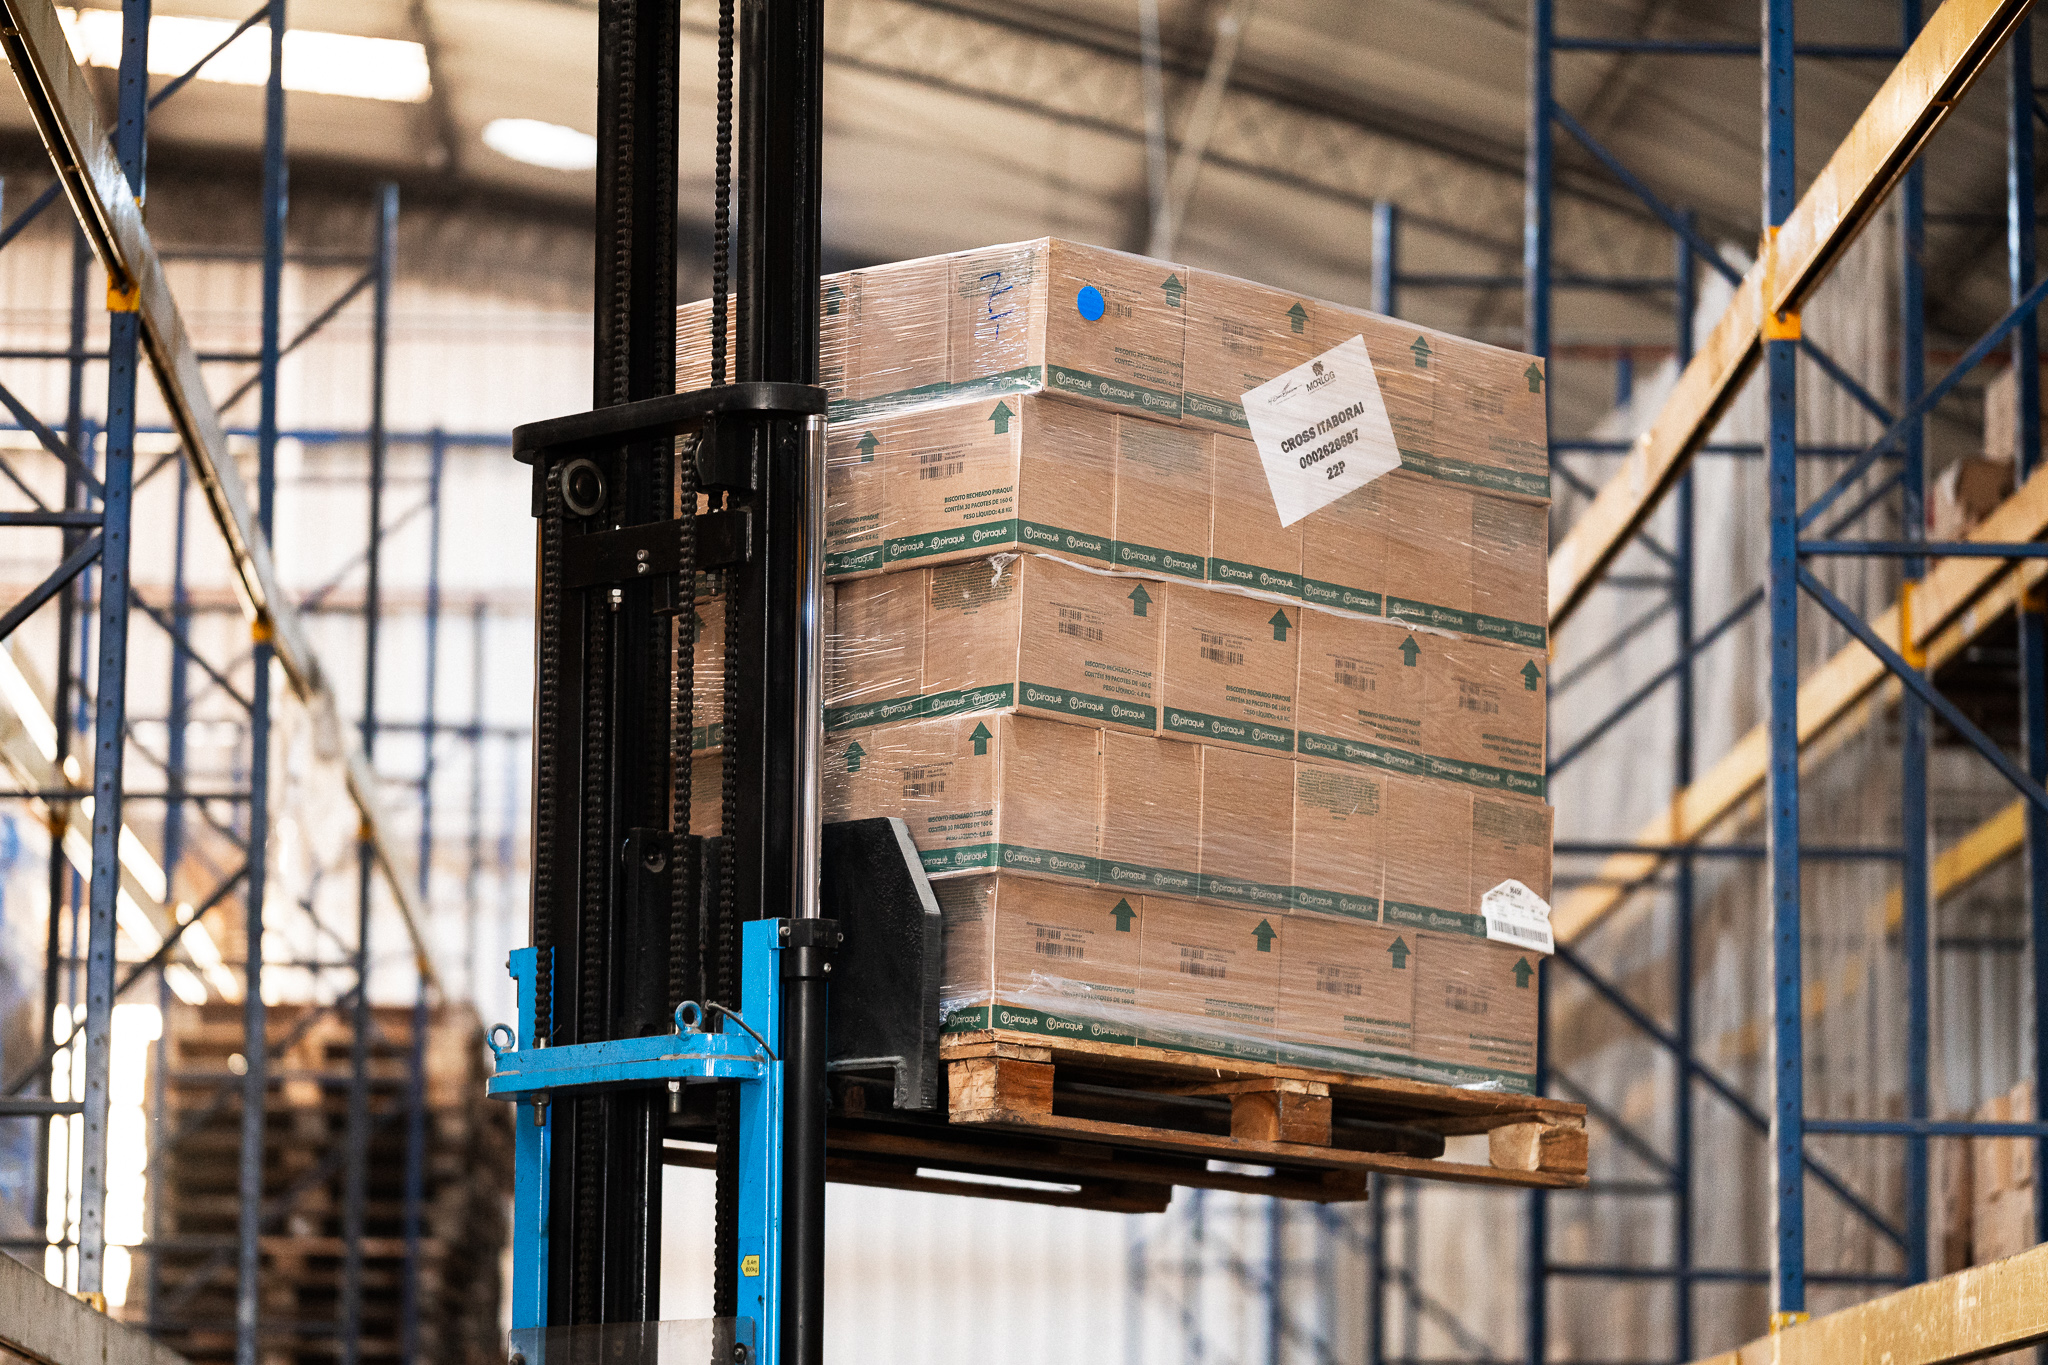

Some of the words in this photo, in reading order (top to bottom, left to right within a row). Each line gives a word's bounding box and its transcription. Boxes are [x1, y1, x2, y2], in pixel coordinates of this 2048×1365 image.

[1306, 371, 1336, 392] MORLOG
[1065, 375, 1092, 389] piraquê
[1109, 386, 1135, 400] piraquê
[1152, 396, 1177, 410] piraquê
[1280, 426, 1316, 454] CROSS
[1317, 402, 1365, 436] ITABORAI
[1326, 460, 1346, 480] 22P
[945, 494, 965, 503] BISCOITO
[966, 490, 991, 499] RECHEADO
[992, 486, 1013, 495] PIRAQUÊ
[945, 505, 964, 513] CONTÉM
[971, 500, 991, 508] PACOTES
[976, 510, 997, 518] LÍQUIDO:
[900, 541, 924, 554] piraquê
[940, 534, 965, 548] piraquê
[981, 527, 1008, 540] piraquê
[1033, 529, 1059, 543] piraquê
[1076, 539, 1101, 551] piraquê
[1131, 551, 1156, 563] piraquê
[1172, 559, 1198, 571] piraquê
[1229, 568, 1253, 580] piraquê
[1269, 575, 1293, 588] piraquê
[1312, 586, 1337, 600] piraquê
[1351, 594, 1375, 606] piraquê
[889, 703, 913, 715] piraquê
[940, 696, 965, 709] piraquê
[981, 690, 1006, 704] piraquê
[1036, 692, 1062, 704] piraquê
[1078, 700, 1104, 712] piraquê
[1120, 707, 1145, 720] piraquê
[1179, 717, 1204, 728] piraquê
[1220, 724, 1245, 736] piraquê
[1261, 732, 1285, 743] piraquê
[1314, 740, 1338, 752] piraquê
[1392, 755, 1415, 767] piraquê
[1477, 770, 1500, 782] piraquê
[1514, 777, 1537, 788] piraquê
[964, 850, 988, 863] piraquê
[1014, 852, 1041, 865] piraquê
[1059, 860, 1086, 872] piraquê
[1120, 869, 1146, 881] piraquê
[1163, 876, 1189, 887] piraquê
[1218, 883, 1243, 895] piraquê
[1258, 888, 1283, 901] piraquê
[1308, 894, 1333, 906] piraquê
[1348, 901, 1373, 913] piraquê
[1399, 909, 1423, 921] piraquê
[956, 1013, 981, 1025] piraquê
[1010, 1015, 1038, 1027] piraquê
[1056, 1021, 1083, 1032] piraquê
